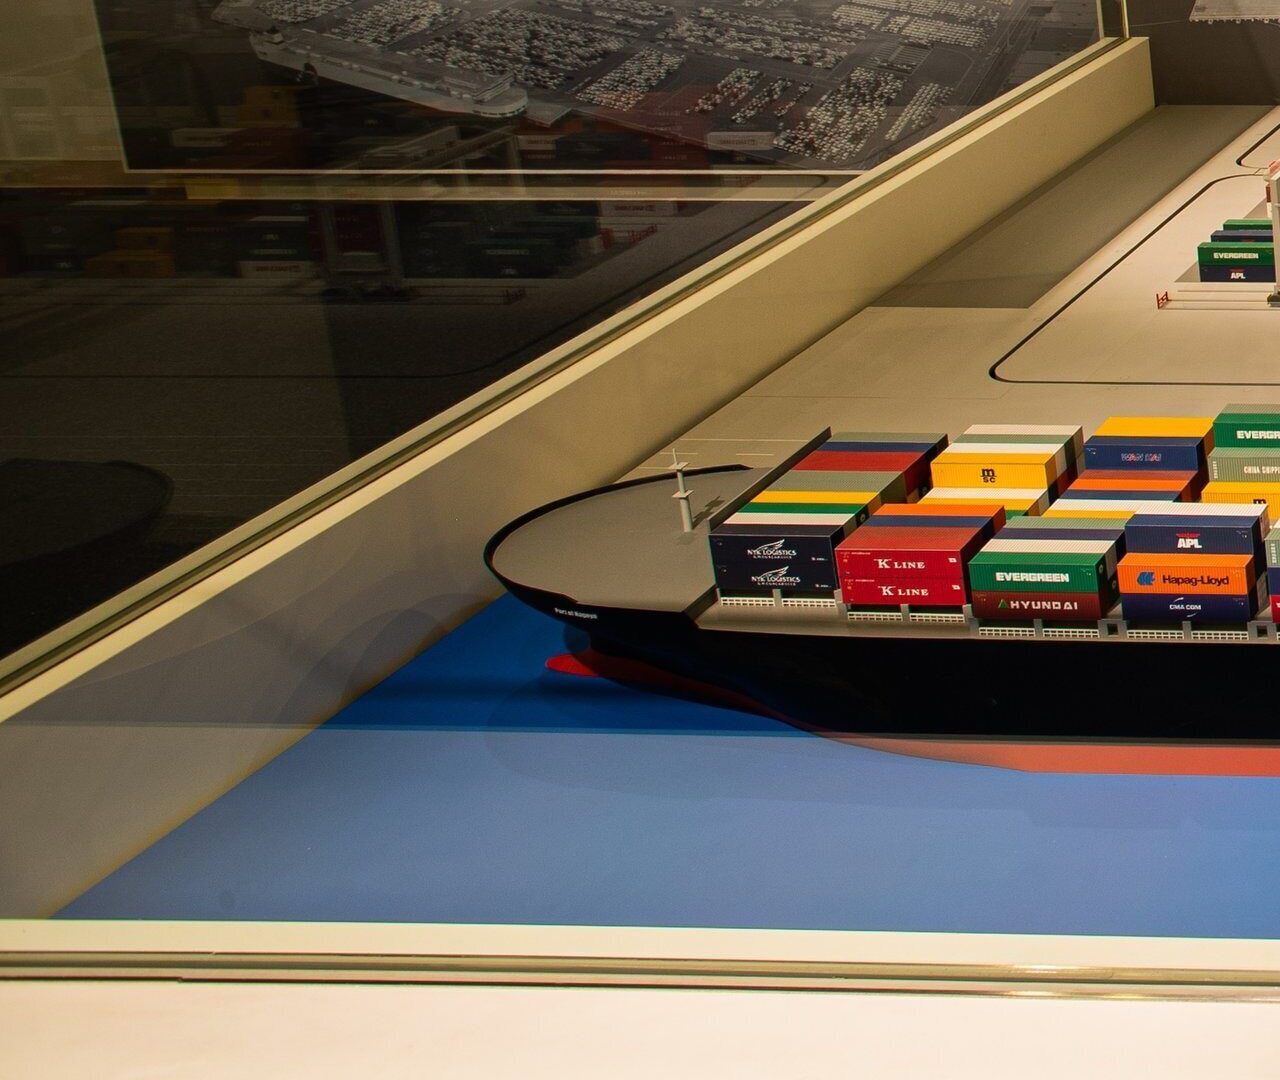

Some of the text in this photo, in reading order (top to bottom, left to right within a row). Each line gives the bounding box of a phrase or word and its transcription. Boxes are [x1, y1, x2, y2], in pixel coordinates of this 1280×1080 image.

[1177, 538, 1202, 548] APL
[995, 572, 1069, 582] EVERGREEN
[1162, 575, 1229, 586] Hapag-Lloyd
[1010, 600, 1077, 609] HYUNDAI
